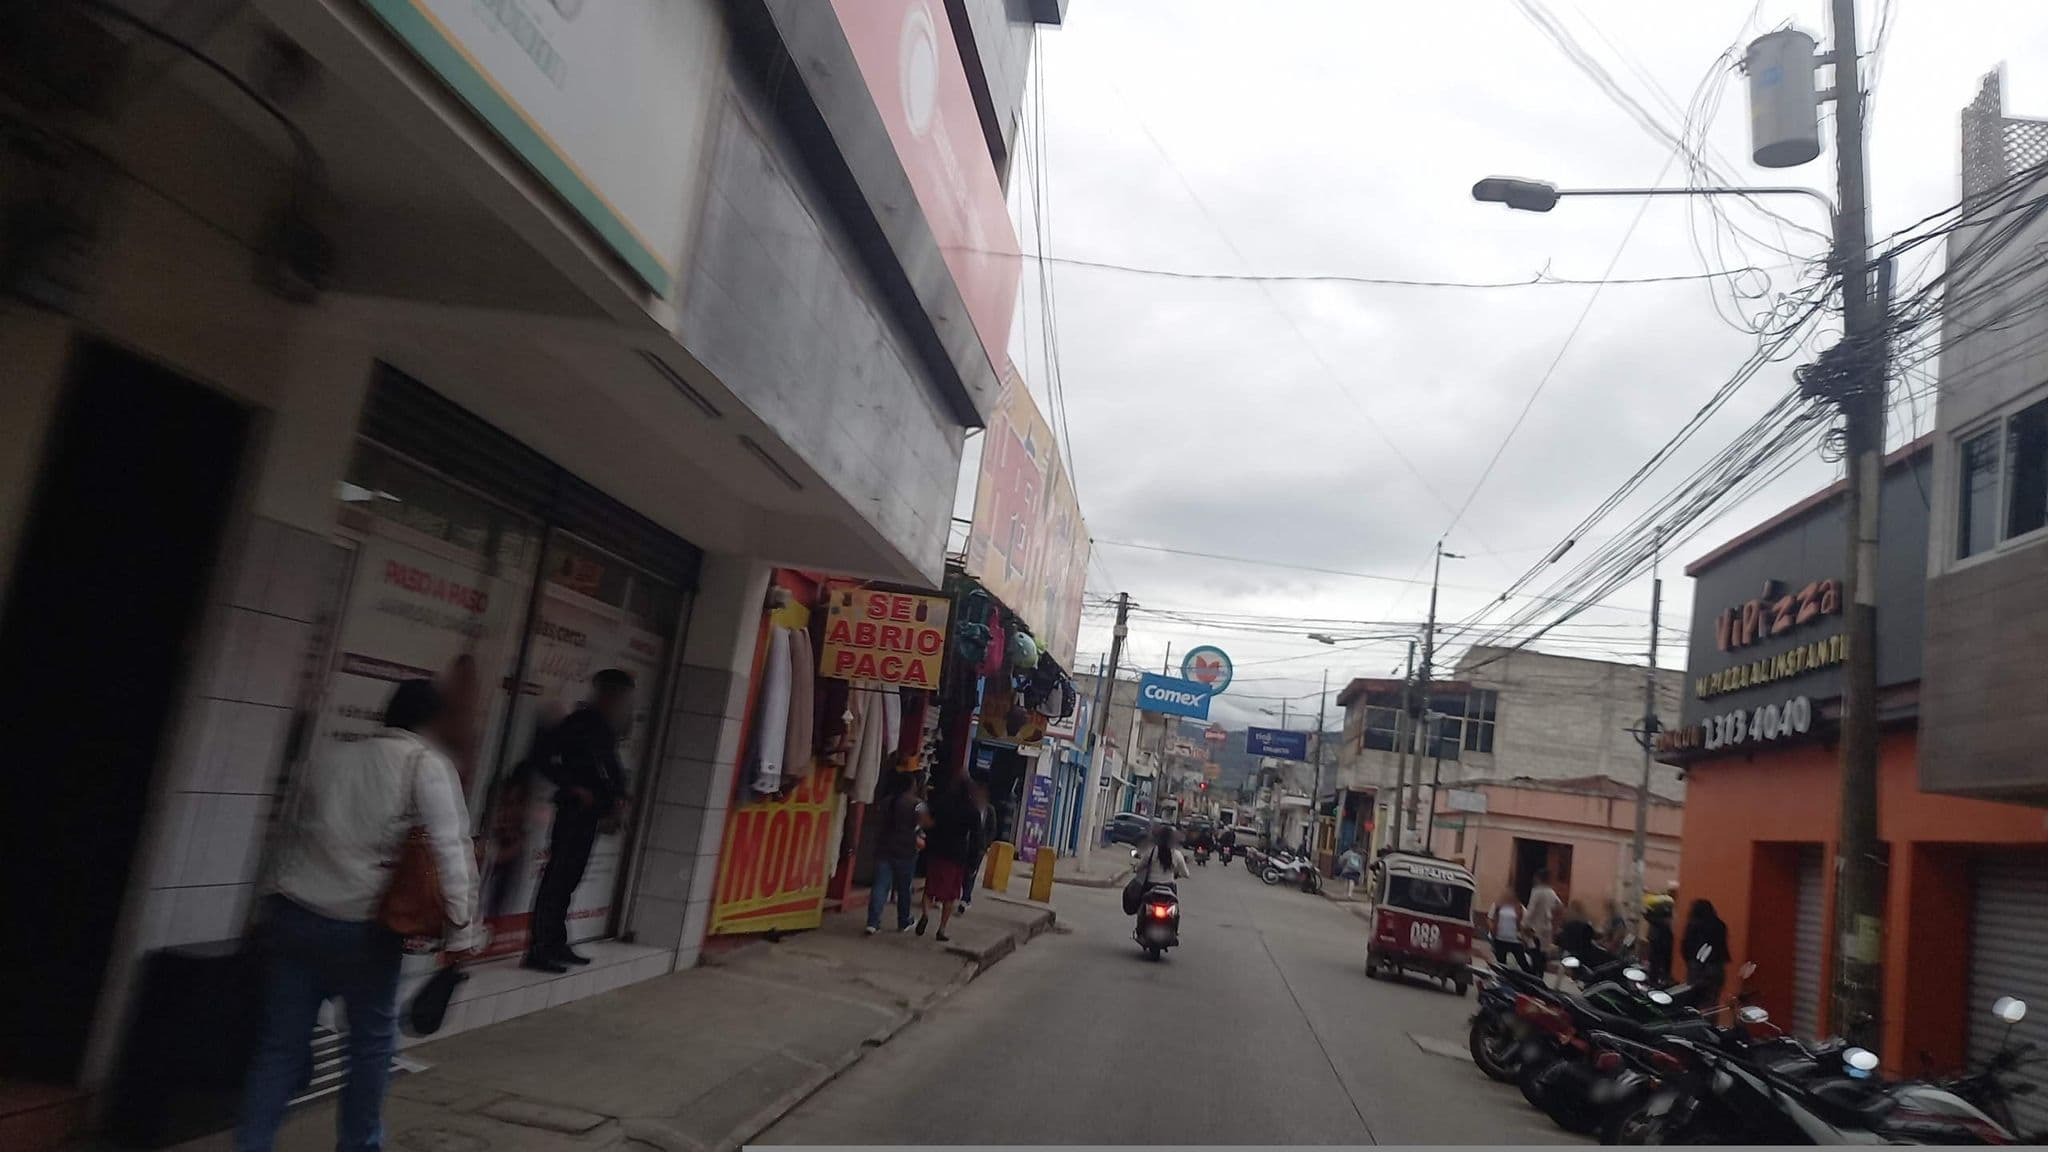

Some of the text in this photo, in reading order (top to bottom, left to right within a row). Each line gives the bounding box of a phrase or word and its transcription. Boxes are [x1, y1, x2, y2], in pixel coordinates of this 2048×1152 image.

[867, 593, 914, 622] SE
[828, 620, 944, 654] ABRIO
[835, 649, 929, 686] PACA
[1144, 684, 1207, 708] Comex
[721, 810, 832, 905] MODA
